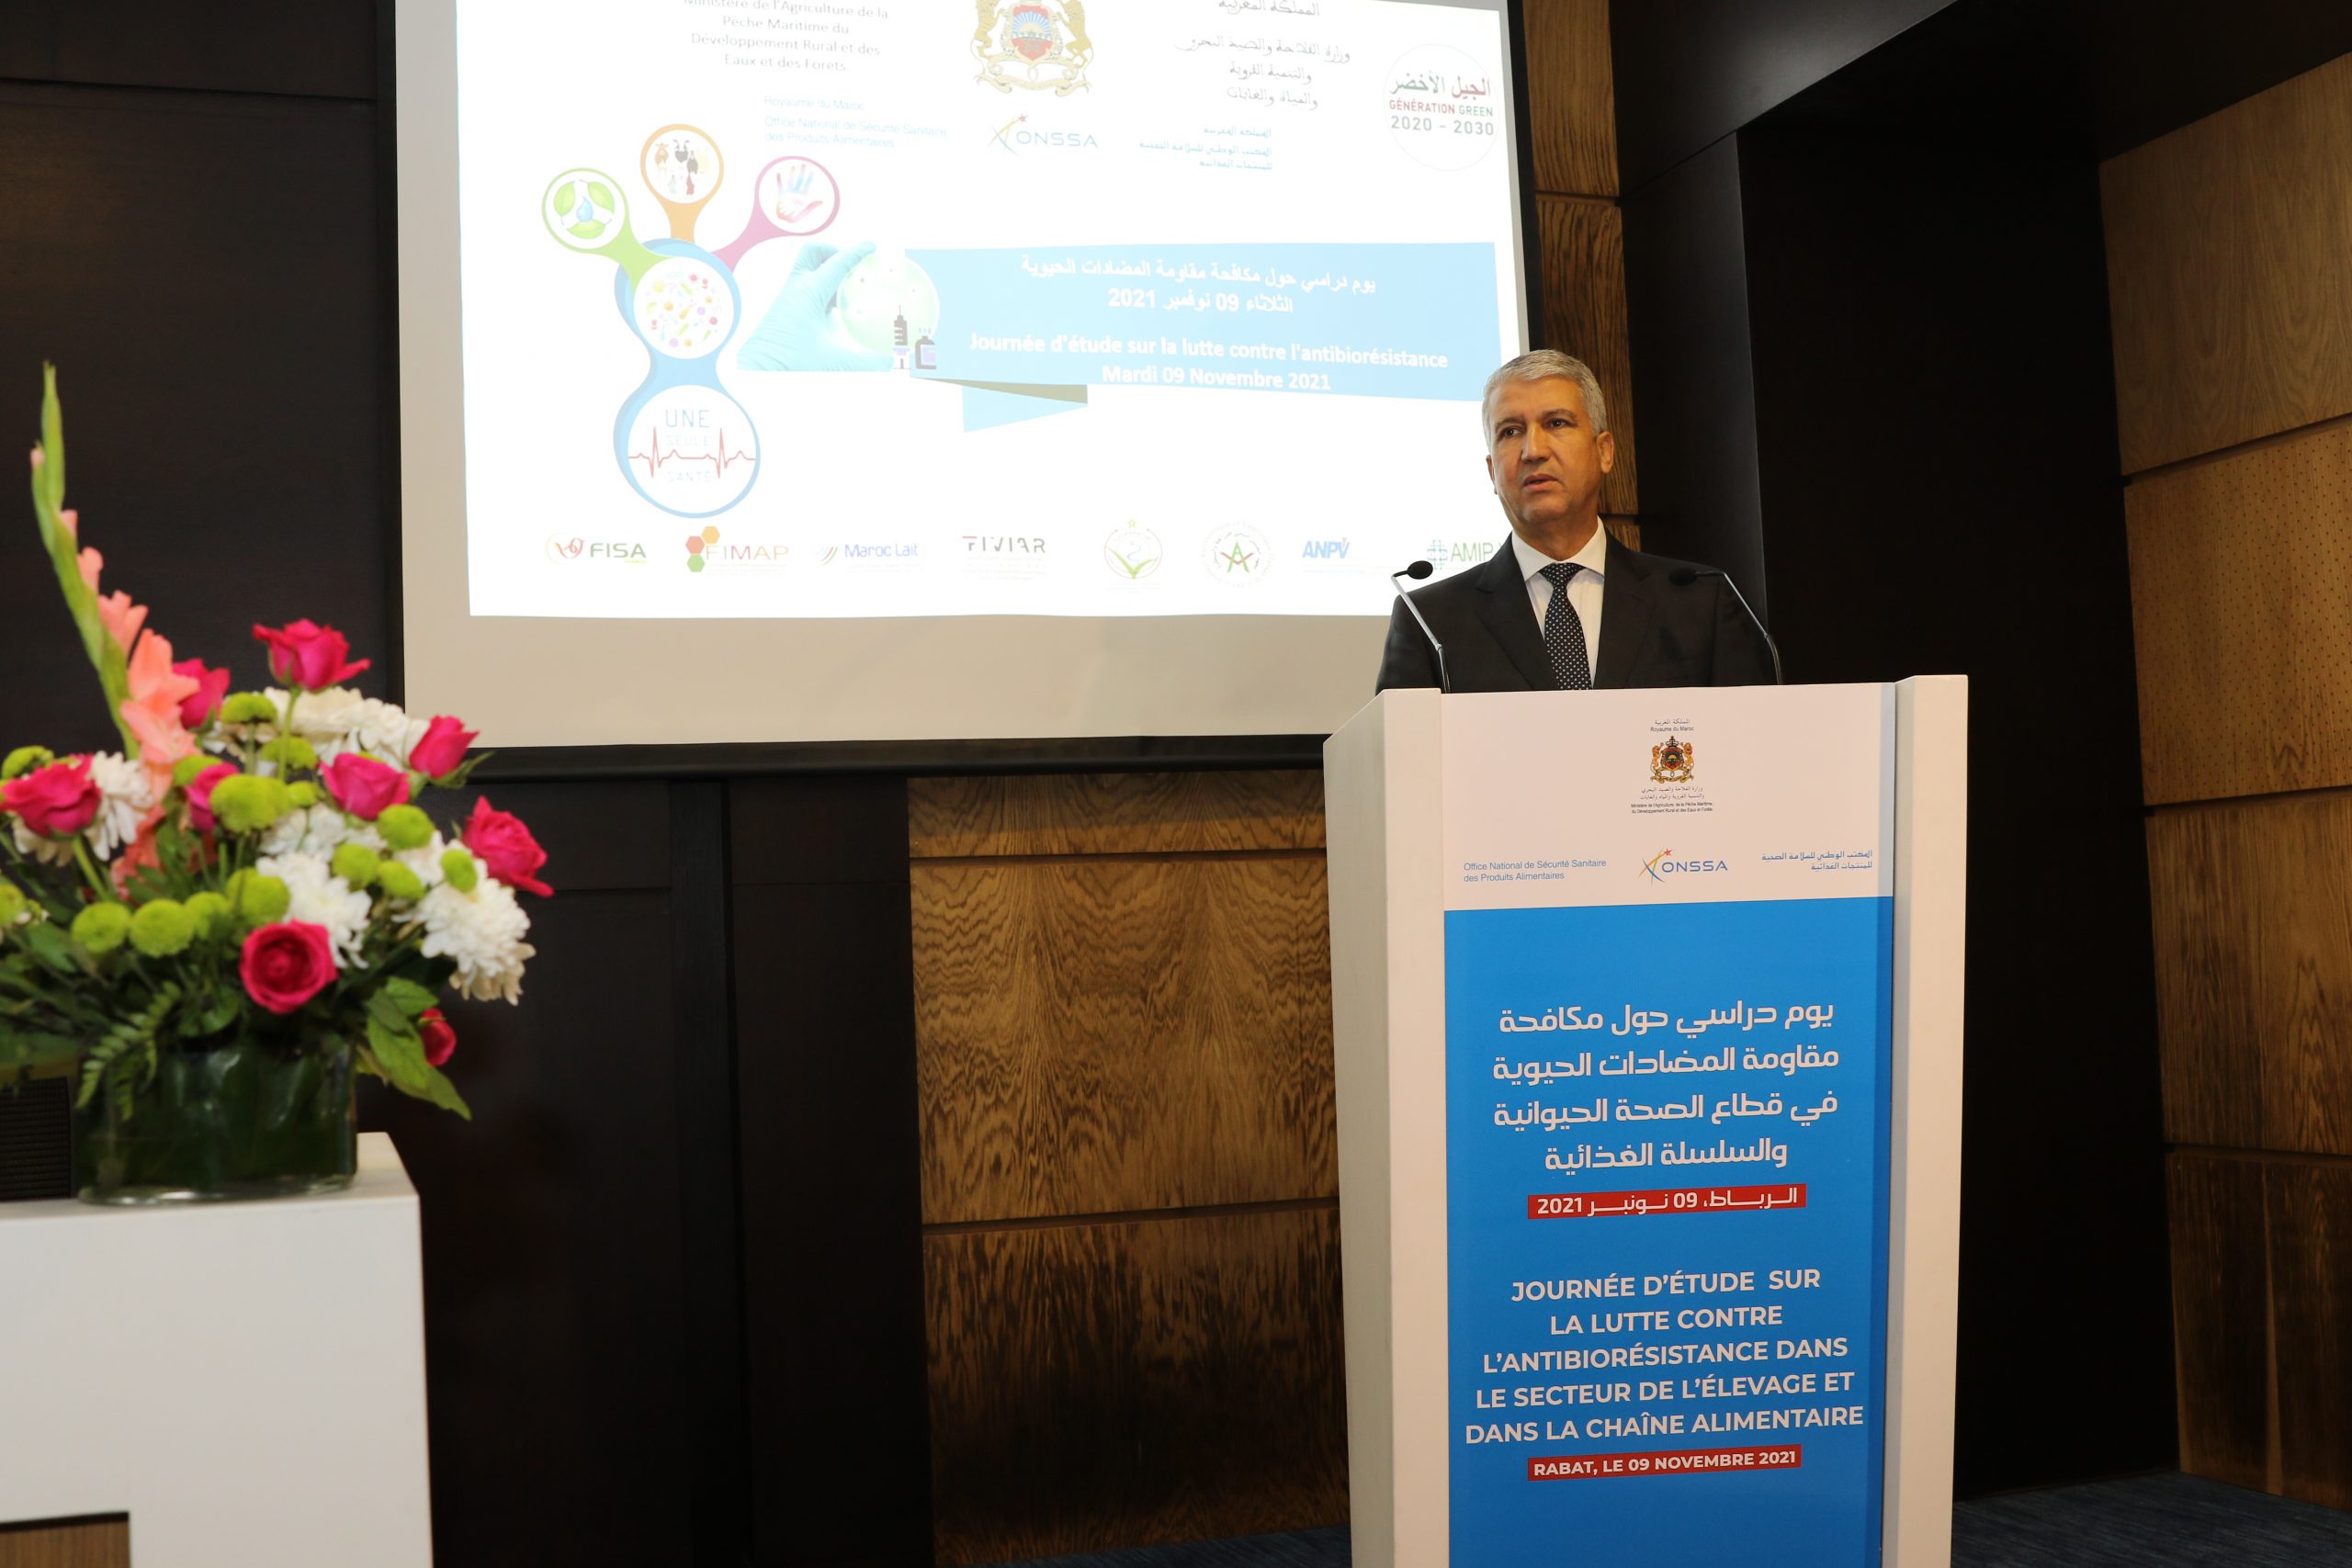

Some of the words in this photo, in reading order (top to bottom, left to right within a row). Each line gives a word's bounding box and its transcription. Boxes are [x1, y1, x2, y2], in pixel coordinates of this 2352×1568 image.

[752, 0, 769, 10] de
[857, 6, 874, 18] de
[876, 7, 889, 19] la
[767, 17, 829, 33] Maritime
[832, 22, 850, 35] du
[802, 39, 837, 53] Rural
[841, 43, 854, 55] et
[857, 43, 881, 57] des
[724, 53, 756, 66] Eaux
[760, 56, 773, 67] et
[777, 56, 800, 70] des
[1388, 70, 1446, 95] الأخضر
[1452, 75, 1490, 101] الجيل
[1388, 97, 1456, 115] GÉNÉRATION
[1459, 105, 1493, 118] GREEN
[1391, 115, 1432, 131] 2020
[1453, 119, 1495, 136] 2030
[1015, 130, 1099, 148] ONSSA
[1021, 254, 1076, 277] الحيوية
[1080, 258, 1150, 276] المضادات
[1156, 259, 1206, 283] مقاومة
[1210, 262, 1261, 283] مكافحة
[1264, 267, 1296, 288] حول
[1300, 272, 1348, 294] دراسي
[1351, 278, 1376, 296] يوم
[1107, 288, 1156, 309] 2021
[1163, 290, 1211, 311] نوفمبر
[1216, 294, 1239, 312] 09
[1246, 294, 1294, 313] الثلاثاء
[969, 332, 1046, 353] Journée
[1050, 334, 1123, 355] d'étude
[1126, 341, 1156, 355] sur
[1160, 337, 1178, 356] la
[1182, 338, 1224, 357] lutte
[1231, 344, 1286, 361] contre
[1290, 343, 1449, 368] l'antibiorésistance
[1102, 365, 1158, 383] Mardi
[1162, 367, 1185, 384] 09
[1190, 367, 1283, 388] Novembre
[1287, 372, 1331, 389] 2021
[665, 409, 710, 428] UNE
[590, 542, 648, 558] FISA
[706, 545, 789, 561] FIMAP
[844, 544, 893, 558] Maroc
[895, 542, 919, 558] Lait
[1302, 540, 1351, 558] ANPV
[1463, 862, 1487, 872] Office
[1489, 861, 1522, 870] National
[1524, 861, 1534, 869] de
[1536, 859, 1569, 869] Sécurité
[1571, 858, 1607, 868] Sanitaire
[1661, 860, 1728, 874] ONSSA
[1463, 874, 1479, 883] des
[1480, 873, 1513, 882] Produits
[1515, 871, 1565, 881] Alimentaires
[1498, 1005, 1603, 1032] مكافحة
[1611, 1003, 1668, 1036] حول
[1676, 999, 1777, 1039] دراسي
[1783, 1004, 1834, 1030] يوم
[1492, 1052, 1591, 1087] الحيوية
[1598, 1046, 1736, 1076] المضادات
[1742, 1043, 1839, 1076] مقاومة
[1493, 1098, 1608, 1133] الحيوانية
[1613, 1094, 1703, 1122] الصحة
[1710, 1092, 1783, 1125] قطاع
[1789, 1090, 1838, 1127] في
[1544, 1142, 1653, 1176] الغذائية
[1659, 1137, 1787, 1168] والسلسلة
[1536, 1196, 1582, 1215] 2021
[1672, 1191, 1698, 1209] 09
[1510, 1273, 1635, 1303] JOURNÉE
[1643, 1269, 1755, 1295] D’ÉTUDE
[1768, 1269, 1821, 1291] SUR
[1550, 1314, 1584, 1336] LA
[1590, 1309, 1670, 1334] LUTTE
[1677, 1304, 1783, 1330] CONTRE
[1482, 1339, 1769, 1374] L’ANTIBIORÉSISTANCE
[1776, 1336, 1848, 1359] DANS
[1476, 1387, 1506, 1409] LE
[1513, 1382, 1631, 1408] SECTEUR
[1638, 1380, 1674, 1402] DE
[1680, 1373, 1816, 1399] L’ÉLEVAGE
[1823, 1371, 1855, 1393] ET
[1464, 1421, 1539, 1445] DANS
[1545, 1419, 1579, 1440] LA
[1585, 1411, 1685, 1438] CHAÎNE
[1691, 1405, 1864, 1434] ALIMENTAIRE
[1532, 1460, 1598, 1478] RABAT,
[1602, 1458, 1624, 1473] LE
[1627, 1456, 1650, 1472] 09
[1654, 1452, 1756, 1471] NOVEMBRE
[1758, 1450, 1797, 1466] 2021
